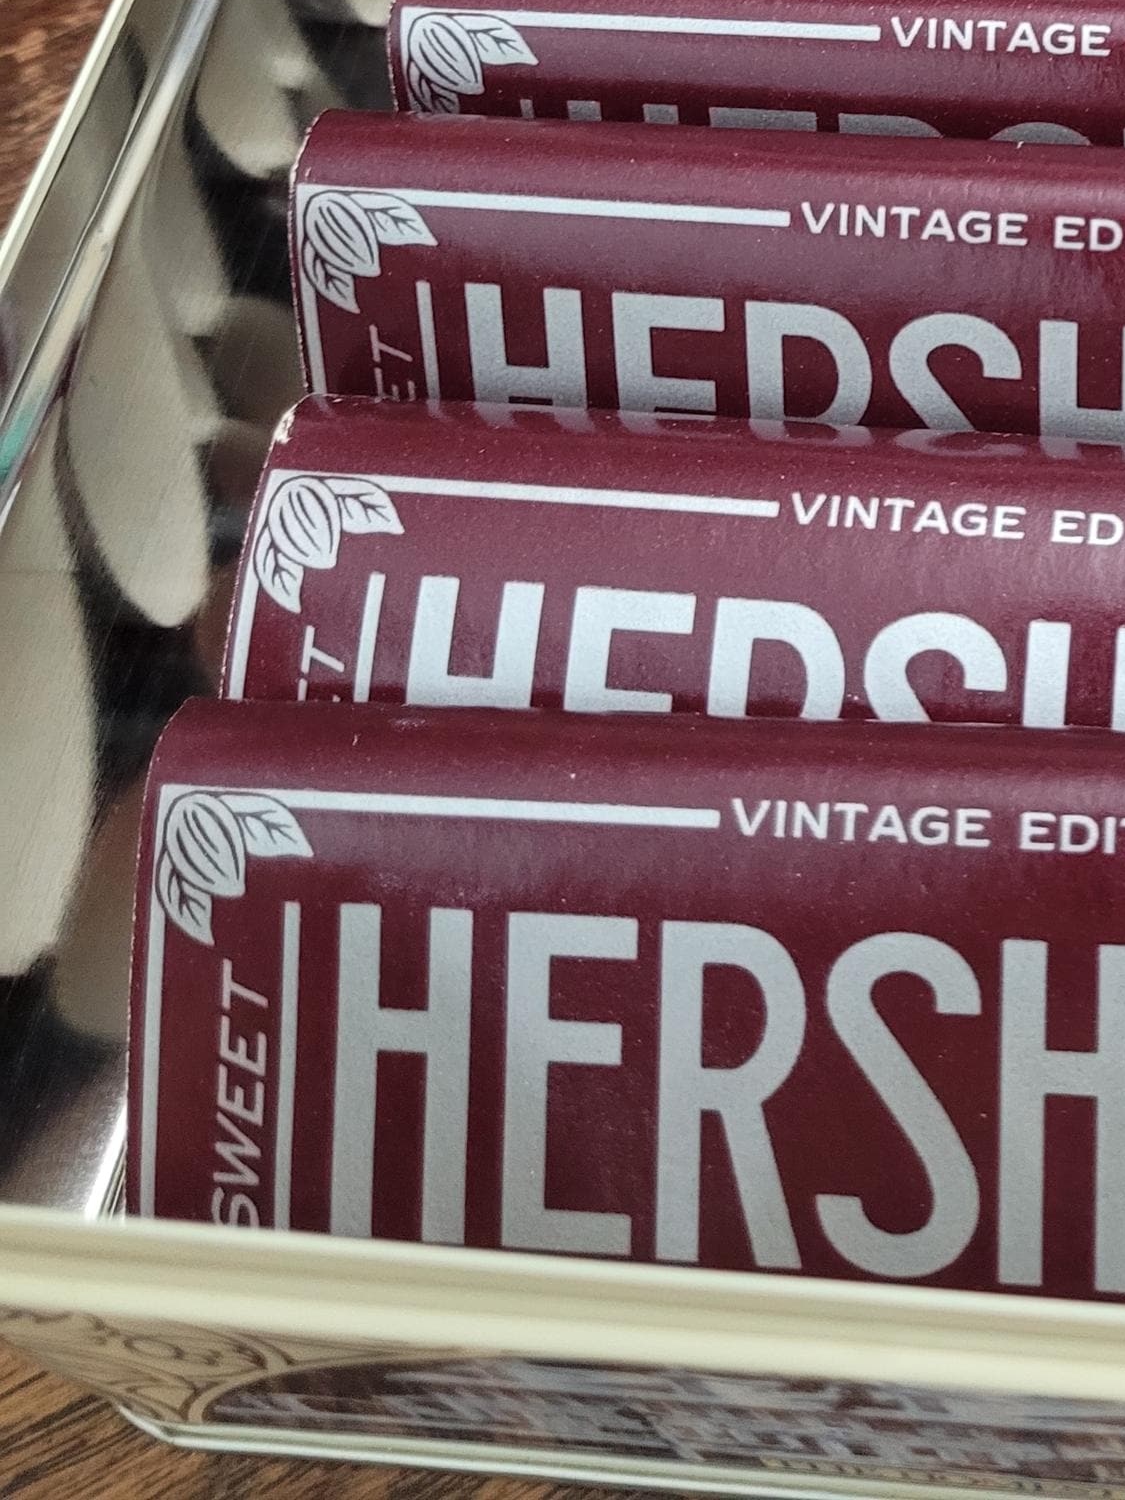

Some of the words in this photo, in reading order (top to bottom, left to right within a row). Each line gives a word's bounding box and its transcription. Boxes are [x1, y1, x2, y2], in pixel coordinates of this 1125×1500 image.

[890, 16, 1111, 57] VINTAGE
[801, 201, 1028, 247] VINTAGE
[791, 492, 1027, 540] VINTAGE
[731, 797, 991, 848] VINTAGE
[211, 958, 268, 1228] SWEET
